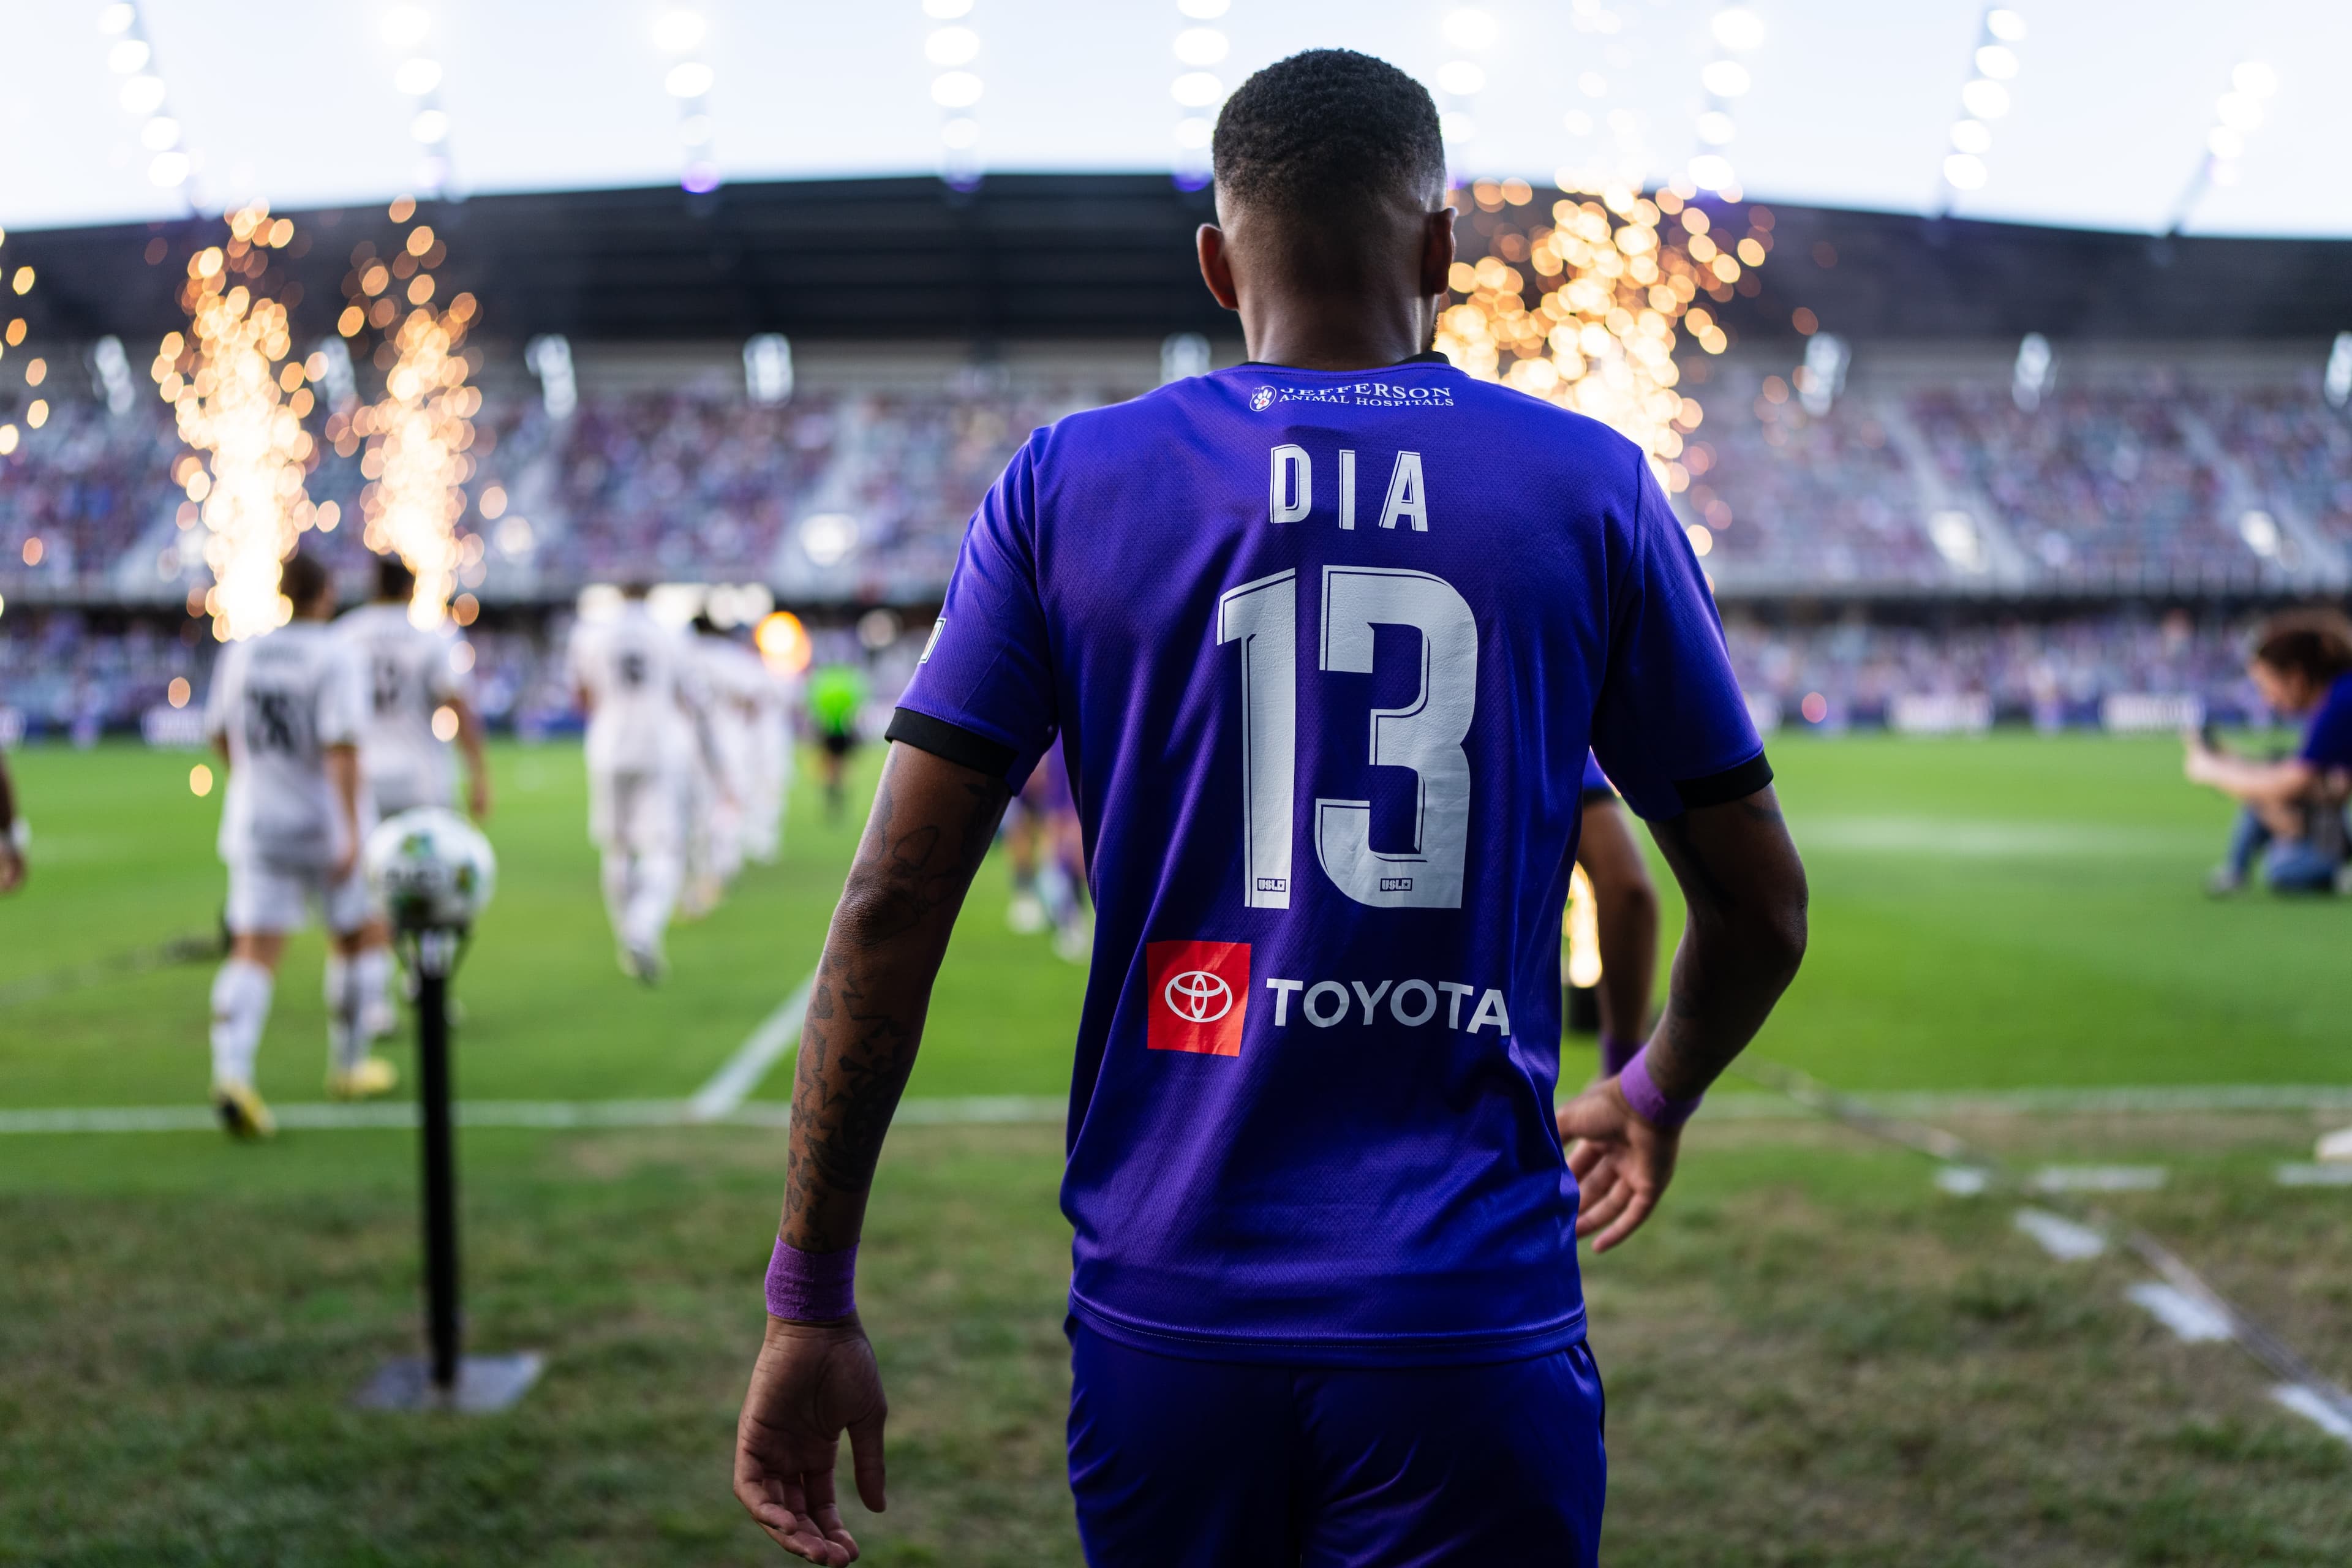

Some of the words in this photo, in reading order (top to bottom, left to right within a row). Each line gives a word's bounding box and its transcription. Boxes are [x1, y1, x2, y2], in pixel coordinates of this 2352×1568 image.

[1278, 394, 1350, 404] ANIMAL
[1355, 398, 1454, 407] HOSPITALS
[1280, 383, 1451, 398] JEFFERSON
[1270, 444, 1428, 532] DIA
[1217, 565, 1478, 909] 13
[1266, 978, 1510, 1036] TOYOTA
